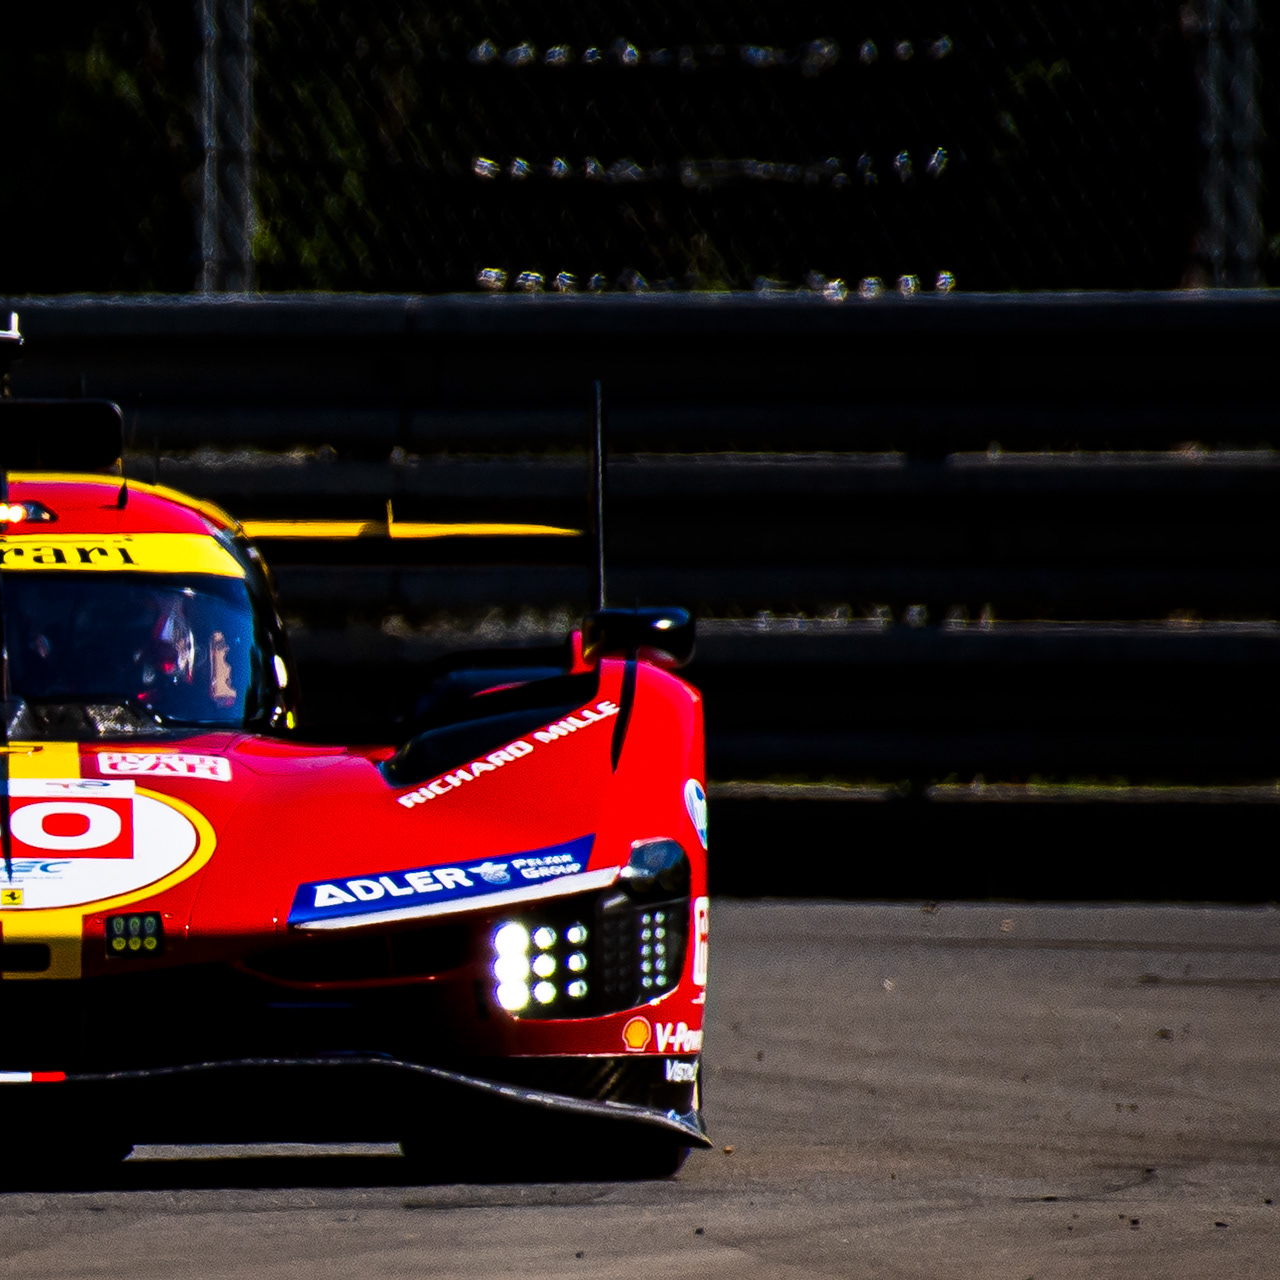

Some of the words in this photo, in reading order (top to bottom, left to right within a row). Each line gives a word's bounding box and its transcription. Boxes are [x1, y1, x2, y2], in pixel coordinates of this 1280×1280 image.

[397, 740, 534, 808] RICHARD
[533, 700, 620, 743] MILLE
[313, 867, 474, 908] ADLER
